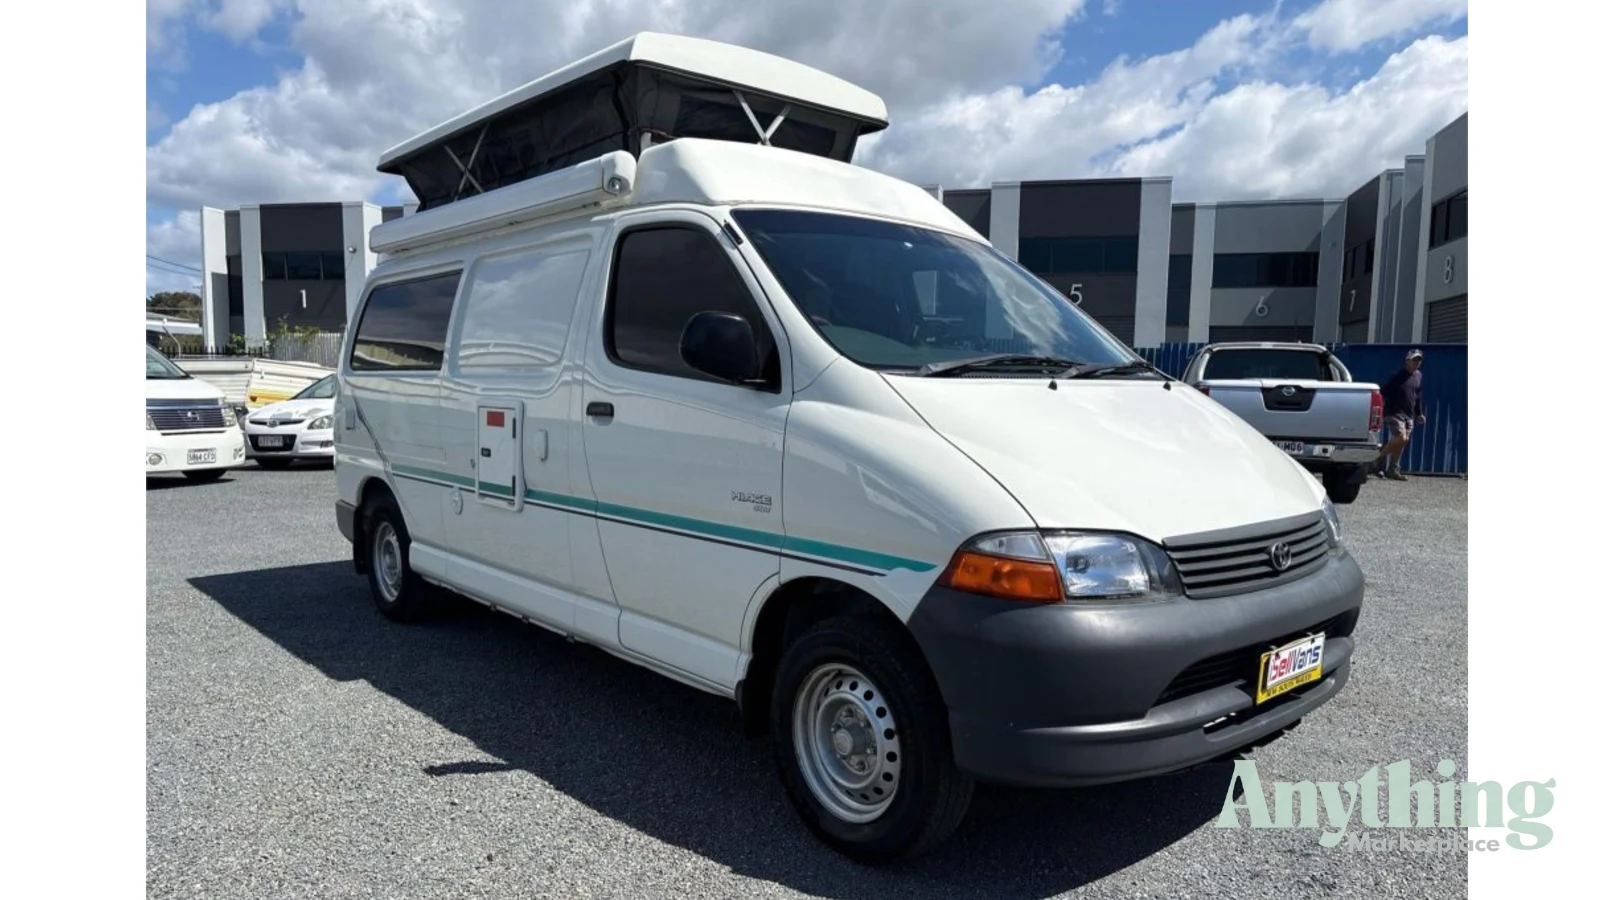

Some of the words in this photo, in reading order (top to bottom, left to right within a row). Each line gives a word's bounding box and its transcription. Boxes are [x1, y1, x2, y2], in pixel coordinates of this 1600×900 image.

[1444, 256, 1454, 284] 8
[300, 289, 307, 308] 1
[1070, 284, 1083, 306] 5
[1255, 297, 1269, 317] 6
